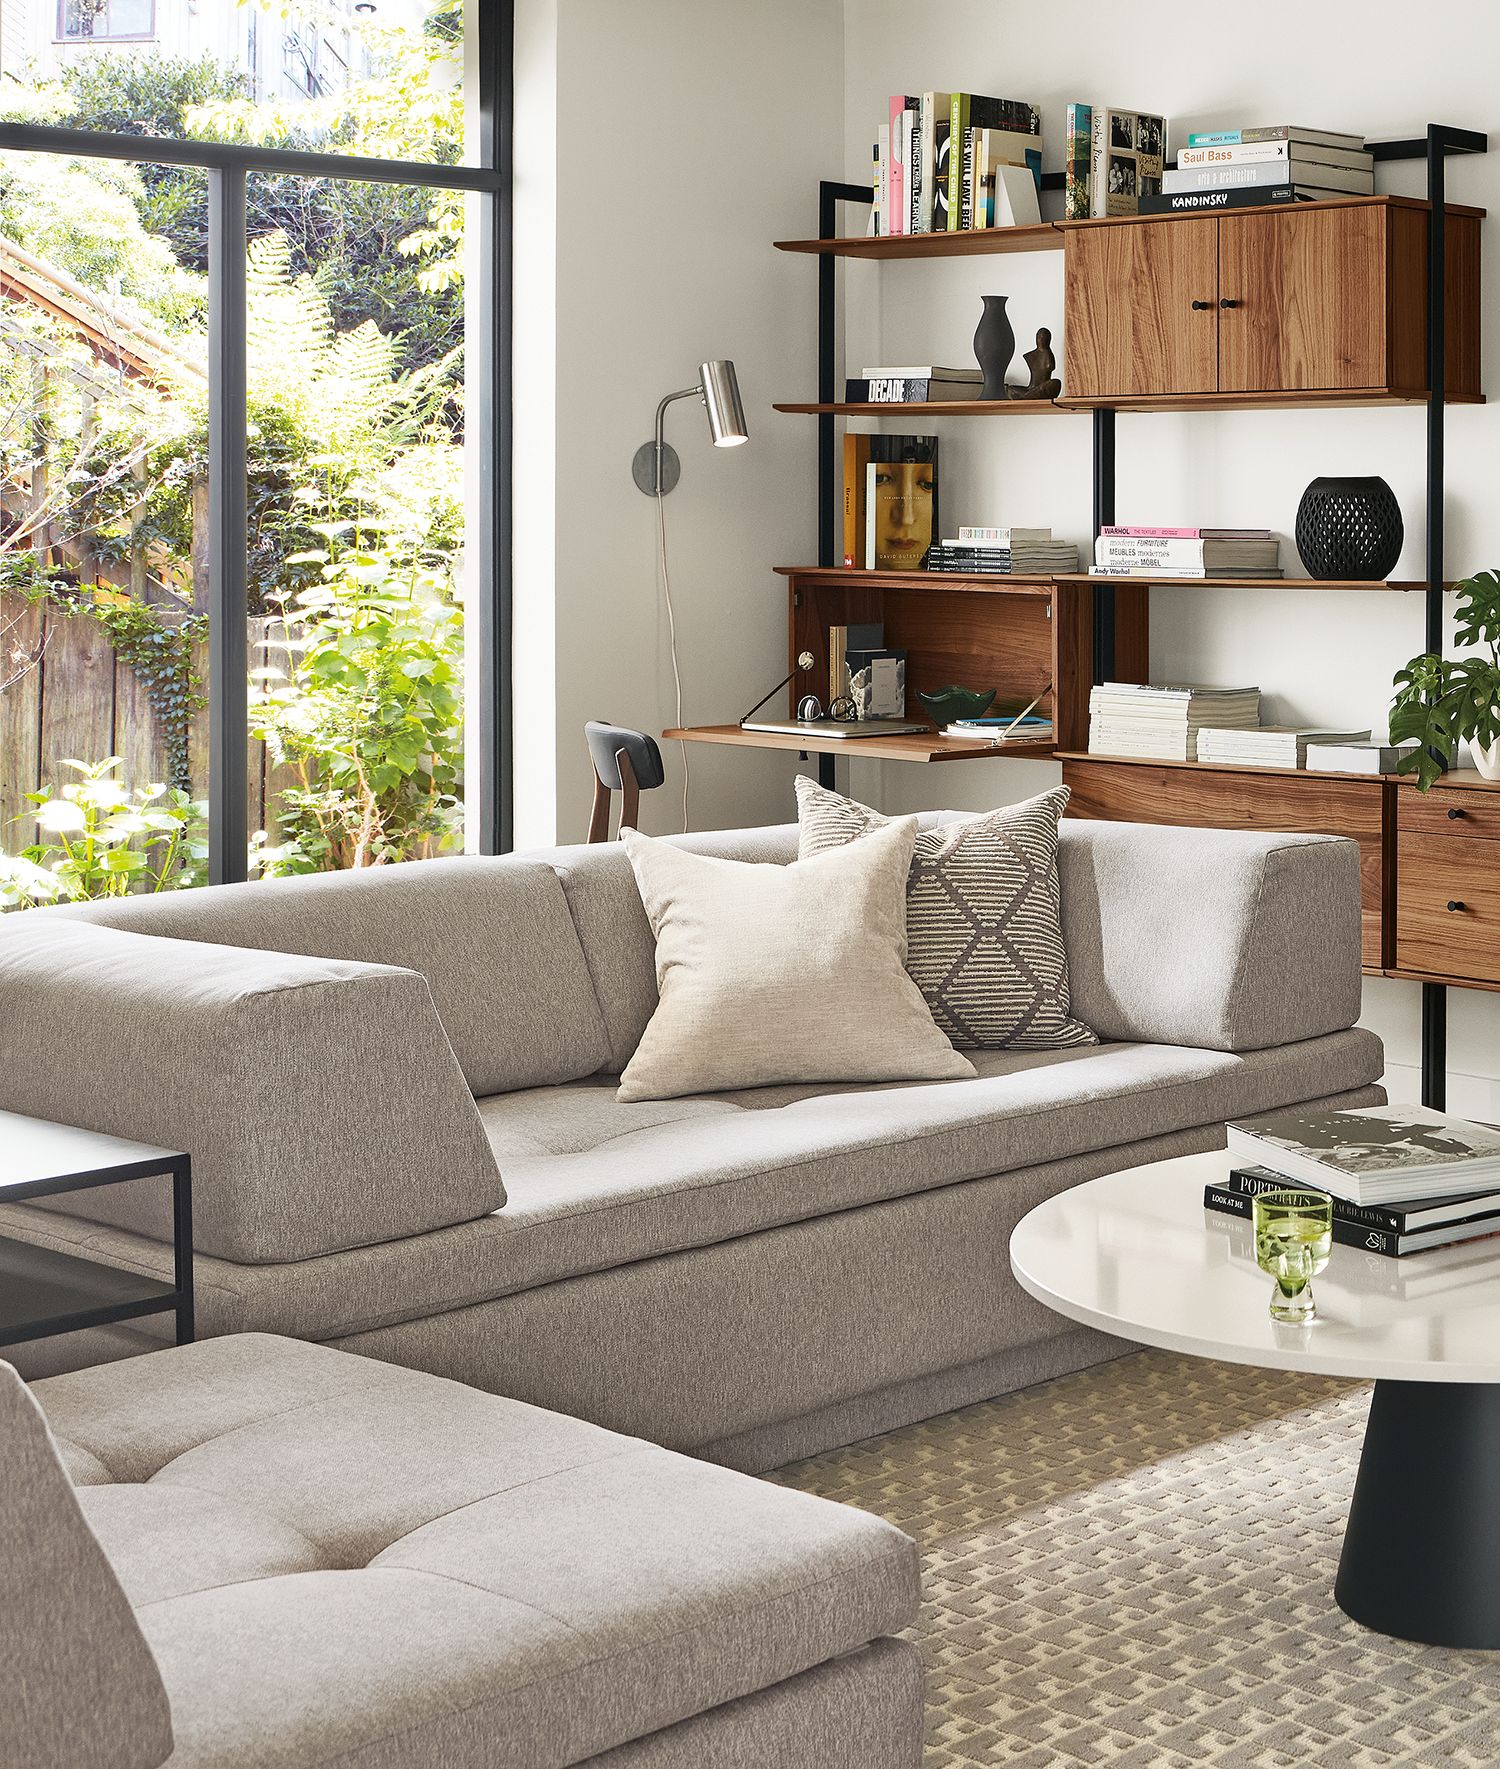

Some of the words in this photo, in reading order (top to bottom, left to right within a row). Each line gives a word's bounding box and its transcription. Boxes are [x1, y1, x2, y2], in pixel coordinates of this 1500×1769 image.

[952, 101, 960, 141] CENTURY
[1092, 115, 1102, 145] Visiting
[964, 127, 972, 149] THIS
[951, 143, 958, 155] OF
[1183, 151, 1205, 163] Saul
[1207, 150, 1232, 161] Bass
[963, 150, 971, 177] WILL
[1093, 148, 1103, 173] Picasso
[949, 177, 957, 203] CHILD
[962, 179, 971, 206] HAVE
[1171, 193, 1228, 208] KANDINSKY
[868, 379, 905, 403] DECADE
[1104, 527, 1130, 535] WARHOL
[1109, 538, 1135, 547] modern
[1136, 539, 1169, 547] FURNITURE
[1109, 548, 1136, 556] MEUBLES
[1137, 549, 1170, 557] modernes
[1110, 558, 1140, 566] moderne
[1211, 1194, 1227, 1204] LOOK
[1227, 1198, 1235, 1206] AT
[1235, 1200, 1244, 1209] ME
[1333, 1202, 1360, 1217] LAURIE
[1360, 1209, 1384, 1223] LEWIS
